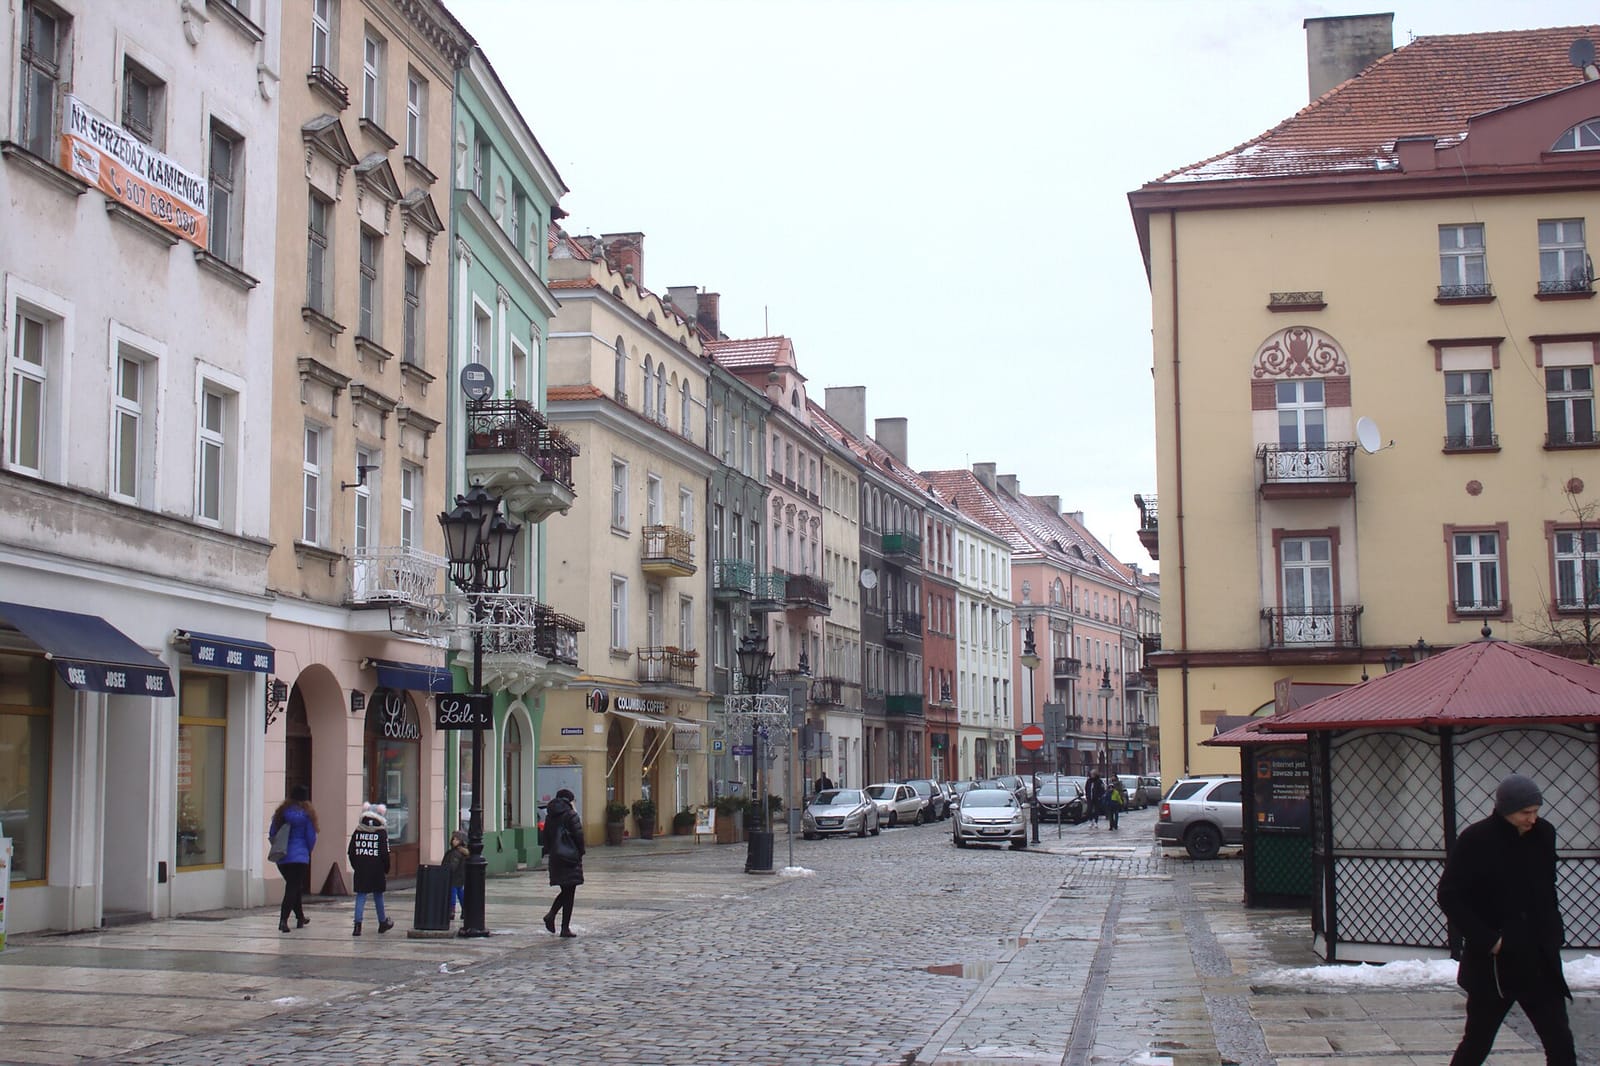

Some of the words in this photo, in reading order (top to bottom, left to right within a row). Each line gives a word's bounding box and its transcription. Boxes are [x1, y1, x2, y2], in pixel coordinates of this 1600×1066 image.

[71, 103, 88, 137] NA
[90, 117, 144, 175] SPRZEDAŻ
[147, 155, 205, 209] KAMIENICA
[126, 179, 147, 209] 607
[150, 194, 173, 223] 680
[175, 208, 196, 236] 080
[198, 646, 215, 661] JOSEF
[227, 650, 242, 665] JOSEF
[254, 654, 269, 668] JOSEF
[68, 667, 86, 684] OSEF
[105, 671, 126, 688] JOSEF
[145, 675, 163, 691] JOSEF
[617, 696, 646, 713] COLUMBUS
[646, 700, 665, 713] COFFEE
[355, 841, 379, 849] MORE
[359, 833, 379, 841] NEED
[355, 848, 379, 857] SPACE
